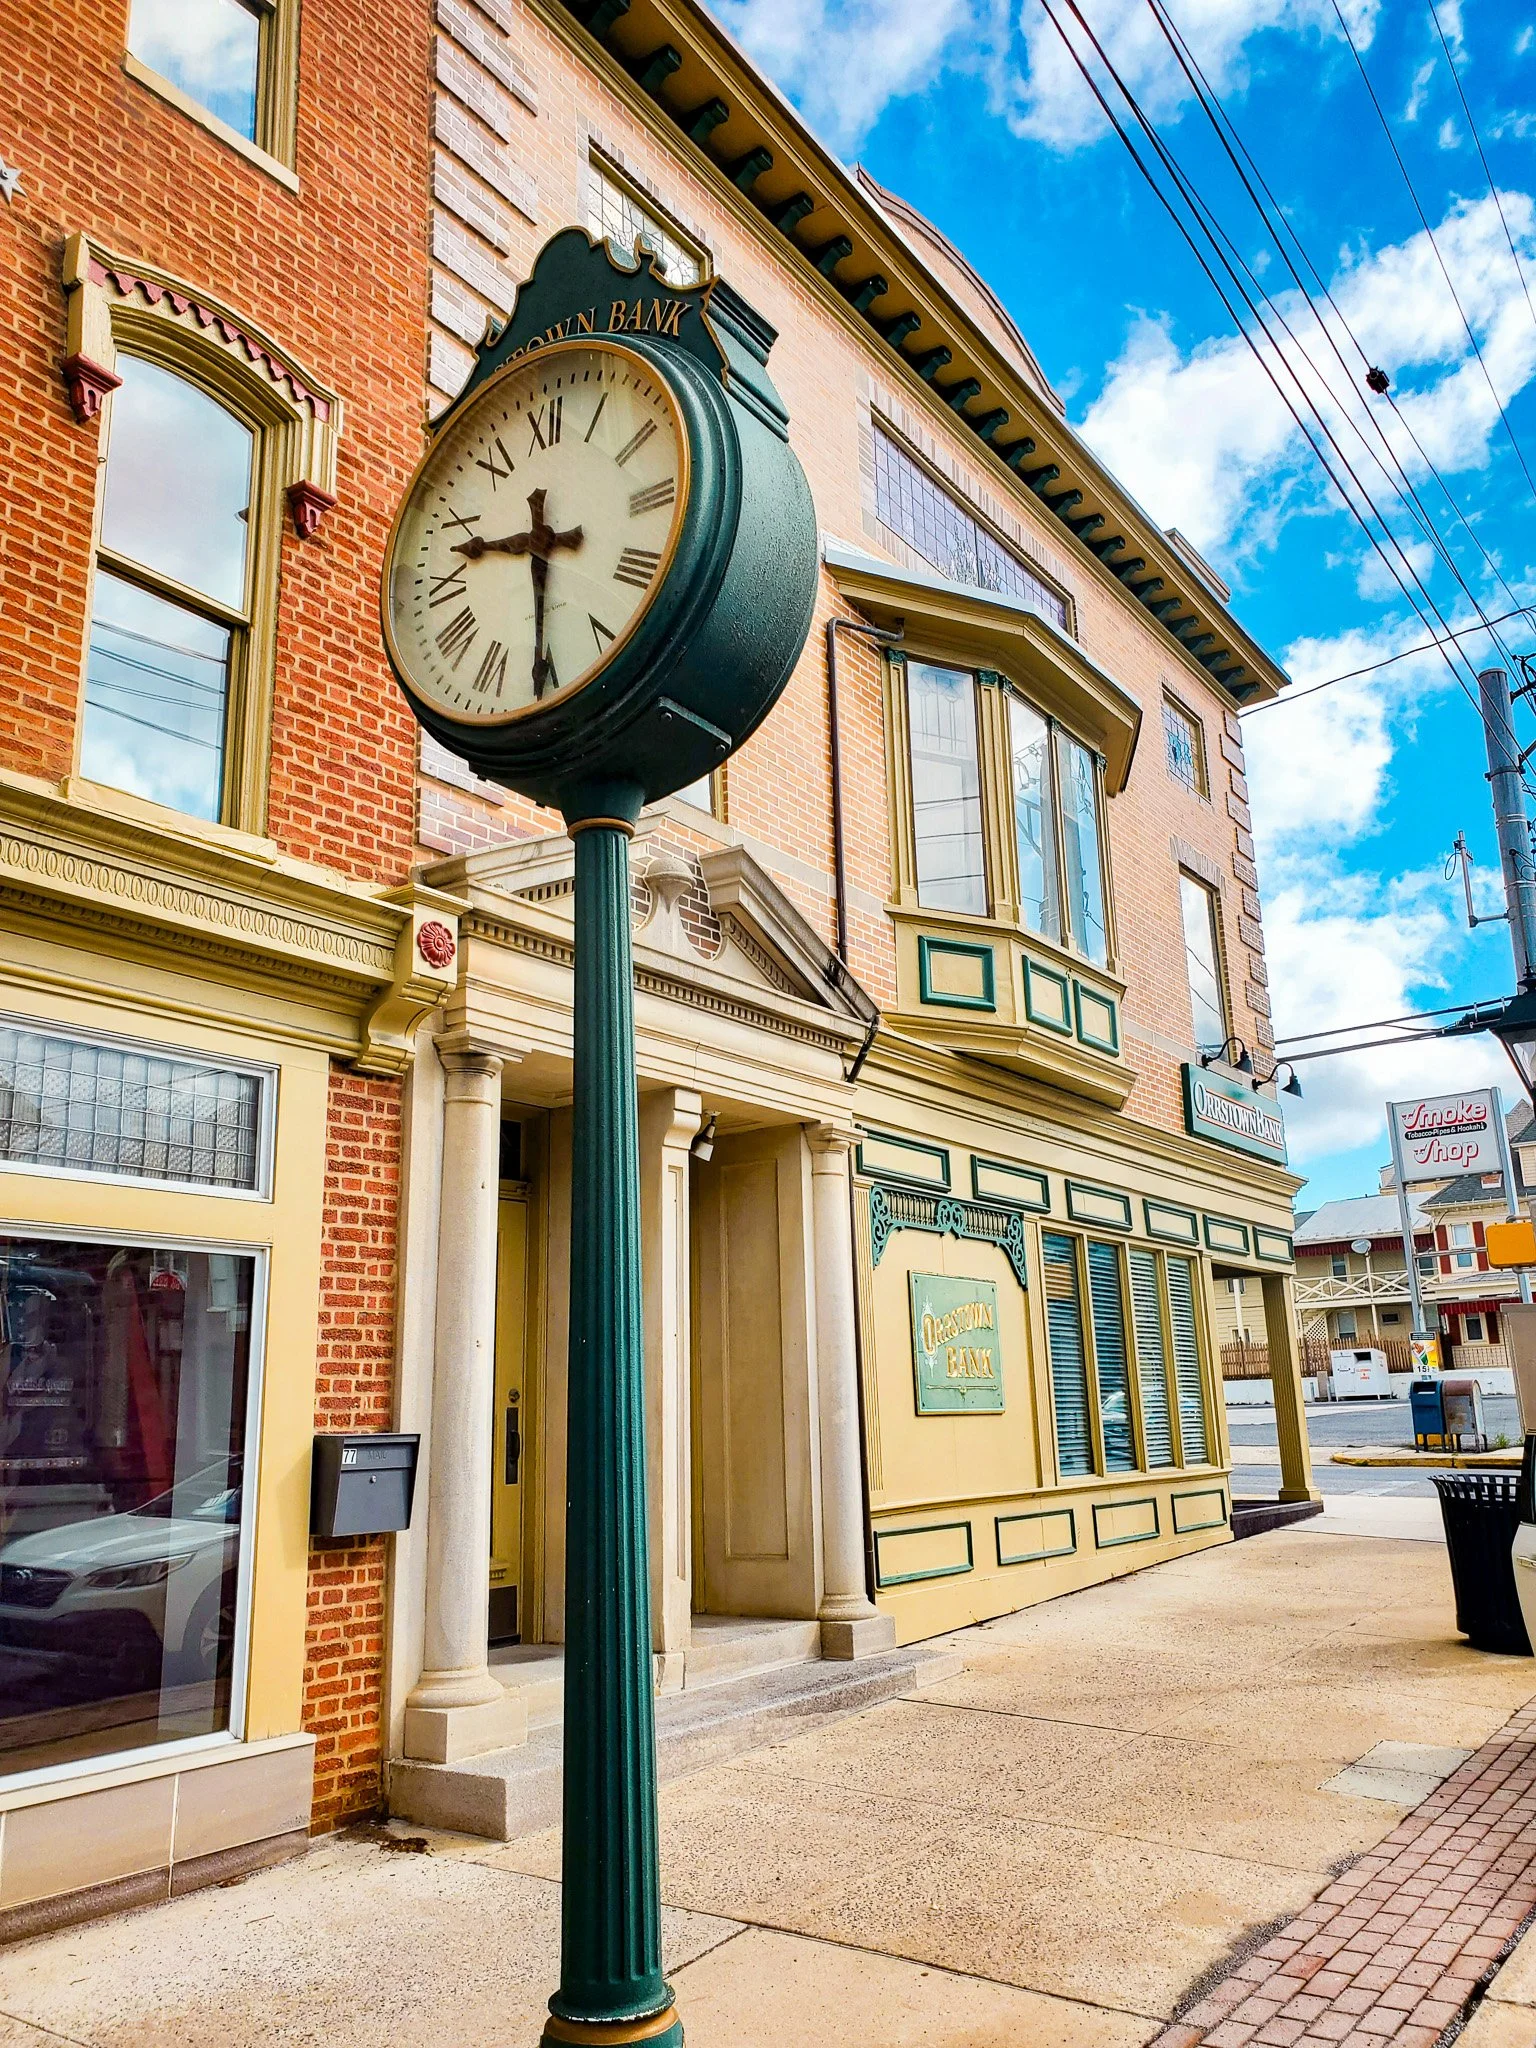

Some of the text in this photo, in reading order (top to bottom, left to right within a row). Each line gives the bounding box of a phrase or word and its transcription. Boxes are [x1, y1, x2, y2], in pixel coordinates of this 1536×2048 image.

[608, 298, 693, 337] BANK
[1401, 1100, 1487, 1129] Smoke
[1457, 1124, 1481, 1133] Hookah
[1413, 1138, 1479, 1168] Shop
[946, 1346, 995, 1379] BANK
[343, 1449, 357, 1463] 77
